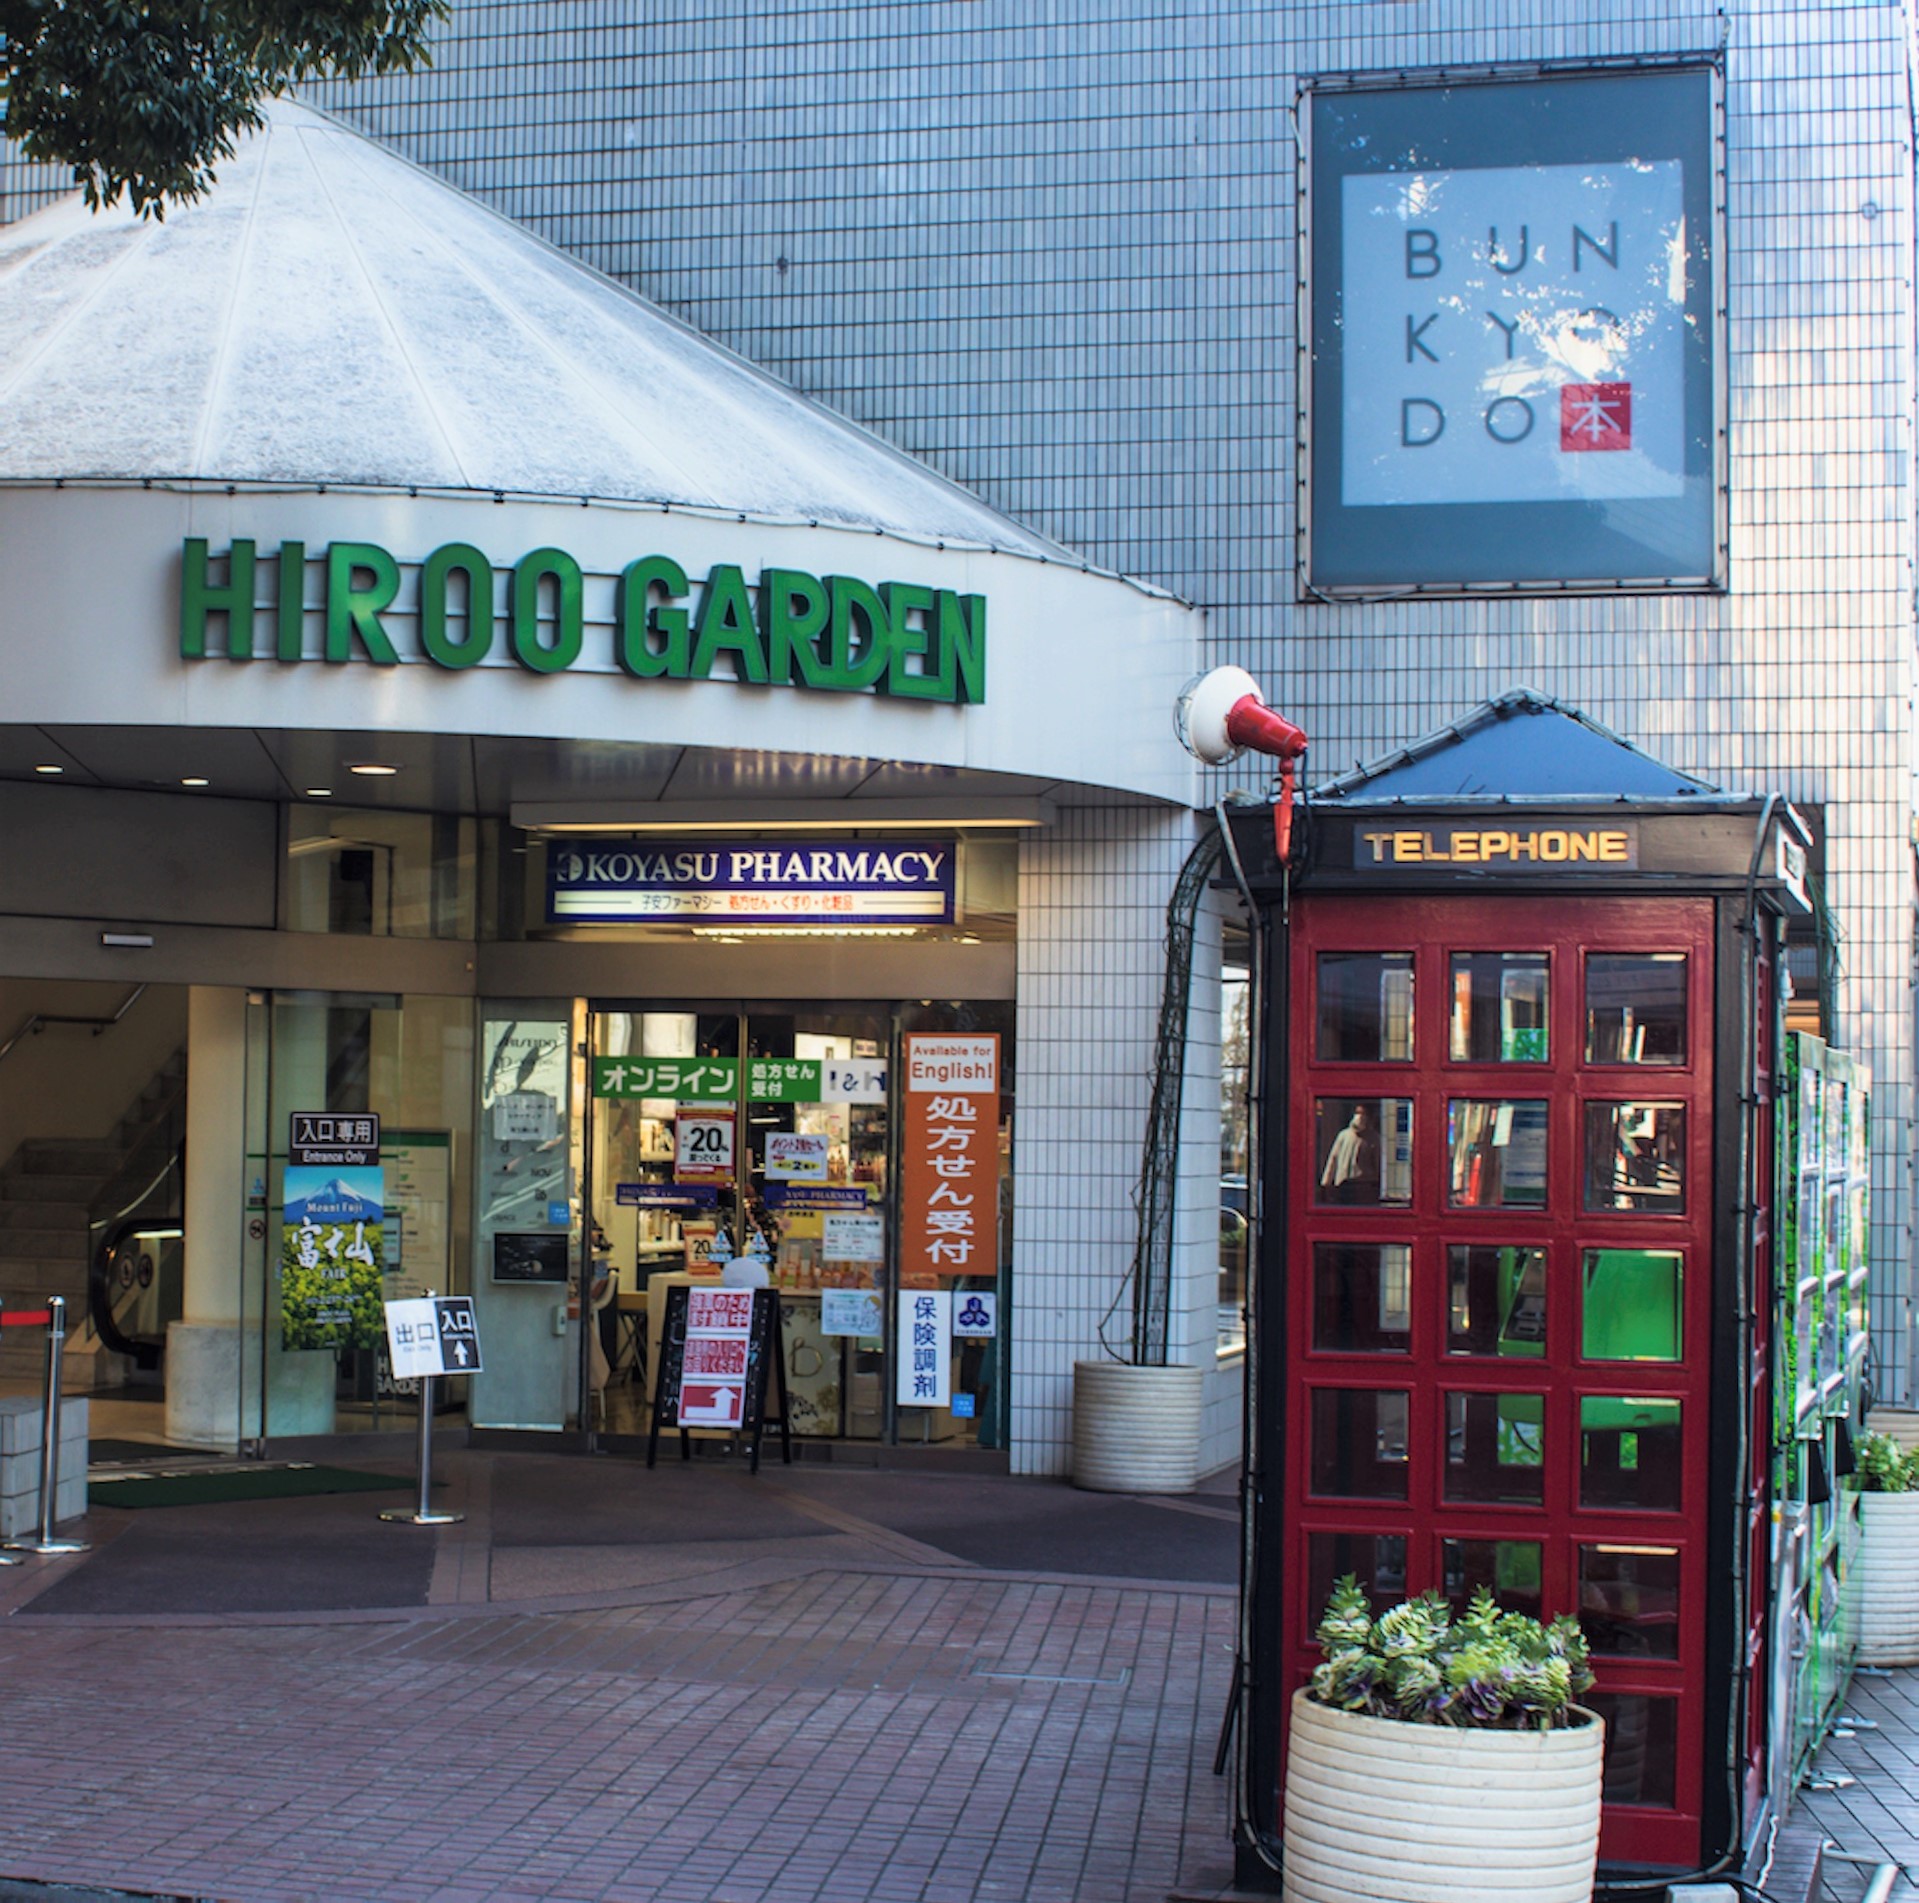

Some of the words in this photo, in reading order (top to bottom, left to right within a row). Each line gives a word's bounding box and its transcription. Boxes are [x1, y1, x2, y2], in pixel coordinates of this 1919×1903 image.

[1569, 393, 1622, 442] 本
[181, 537, 583, 674] HIROO
[617, 555, 986, 705] GARDEN
[1363, 829, 1629, 863] TELEPHONE
[586, 852, 720, 883] KOYASU
[728, 851, 945, 883] PHARMACY
[641, 894, 722, 911] 子安ファーマシー
[913, 1045, 969, 1056] Available
[973, 1045, 991, 1056] for
[602, 1064, 735, 1094] オンライン
[751, 1062, 816, 1080] 処方せん
[912, 1061, 993, 1083] English!
[751, 1080, 783, 1098] 受付
[300, 1118, 372, 1144] 入口専用
[302, 1150, 344, 1164] Entrance
[345, 1150, 367, 1165] Only
[925, 1095, 978, 1265] 処方せん受付
[307, 1202, 340, 1213] Mount
[342, 1201, 363, 1215] Fuji
[291, 1215, 375, 1270] 富士山
[320, 1268, 347, 1280] FAIR
[440, 1310, 473, 1332] 入口
[395, 1322, 435, 1345] 出口
[913, 1295, 937, 1399] 保険調剤
